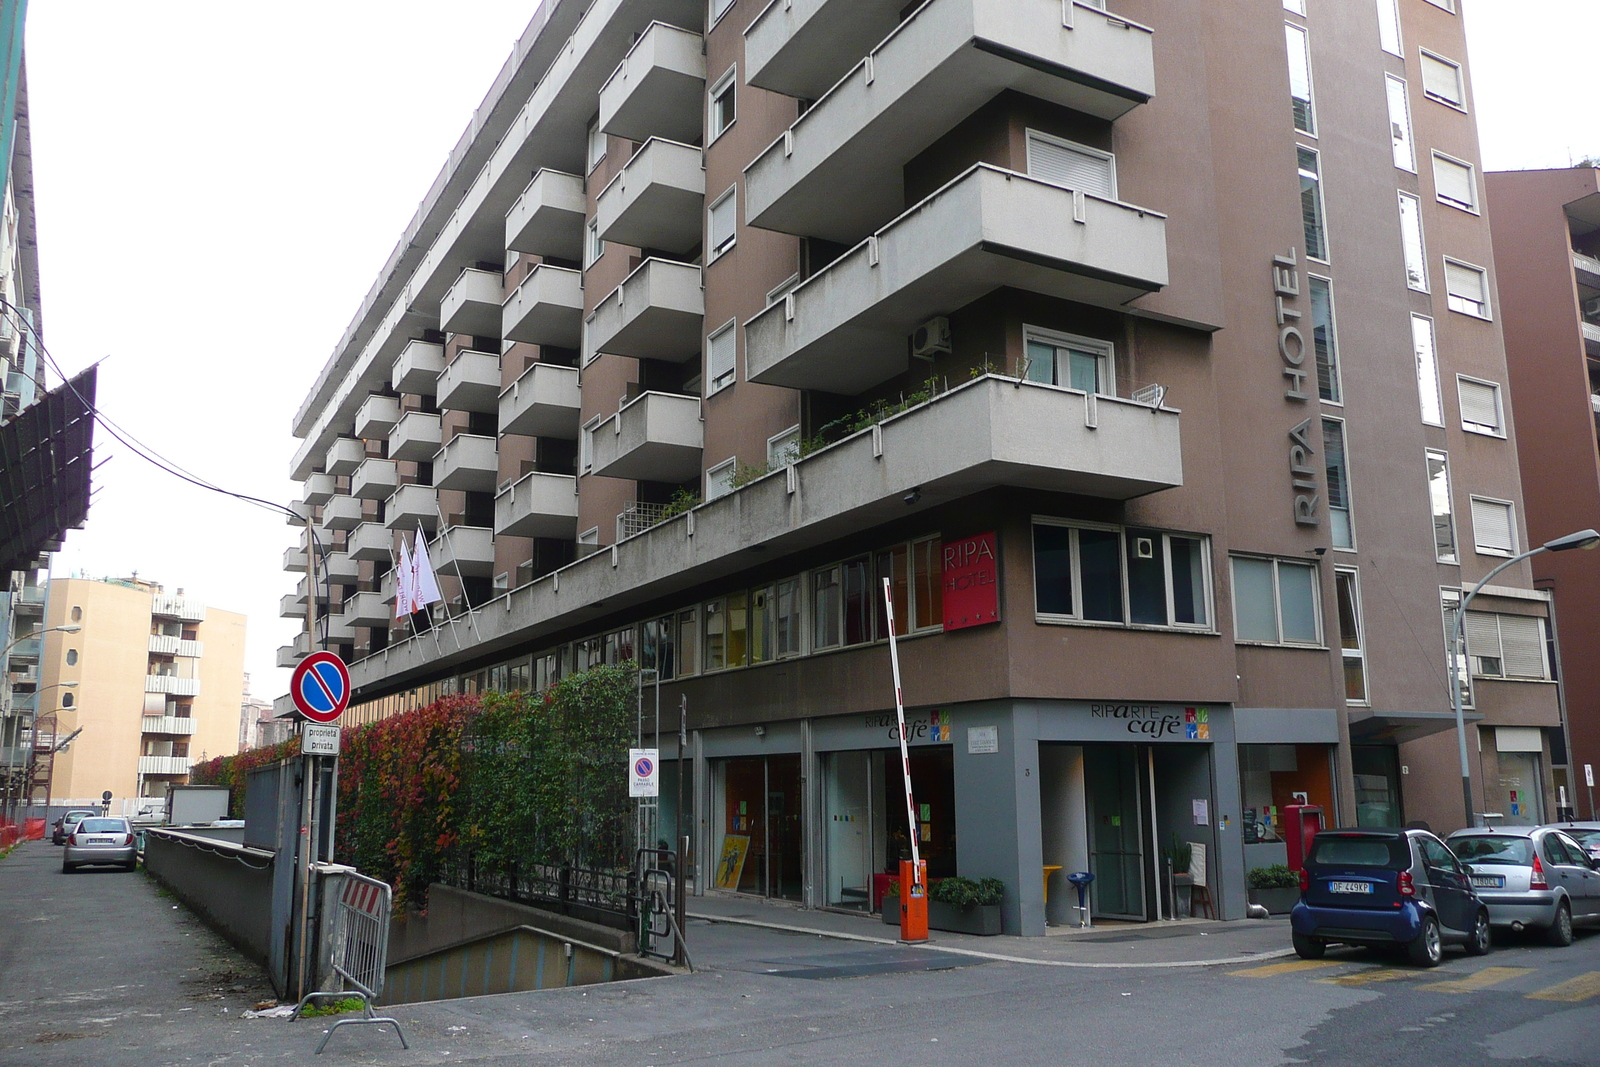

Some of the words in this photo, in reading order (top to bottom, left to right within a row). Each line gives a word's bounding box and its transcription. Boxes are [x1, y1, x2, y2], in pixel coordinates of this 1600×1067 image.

[1273, 246, 1310, 402] HOTEL
[1289, 417, 1321, 527] RIPA
[944, 538, 993, 572] RIPA
[945, 569, 994, 592] HOTEL
[1127, 715, 1181, 738] café
[311, 742, 334, 750] privata
